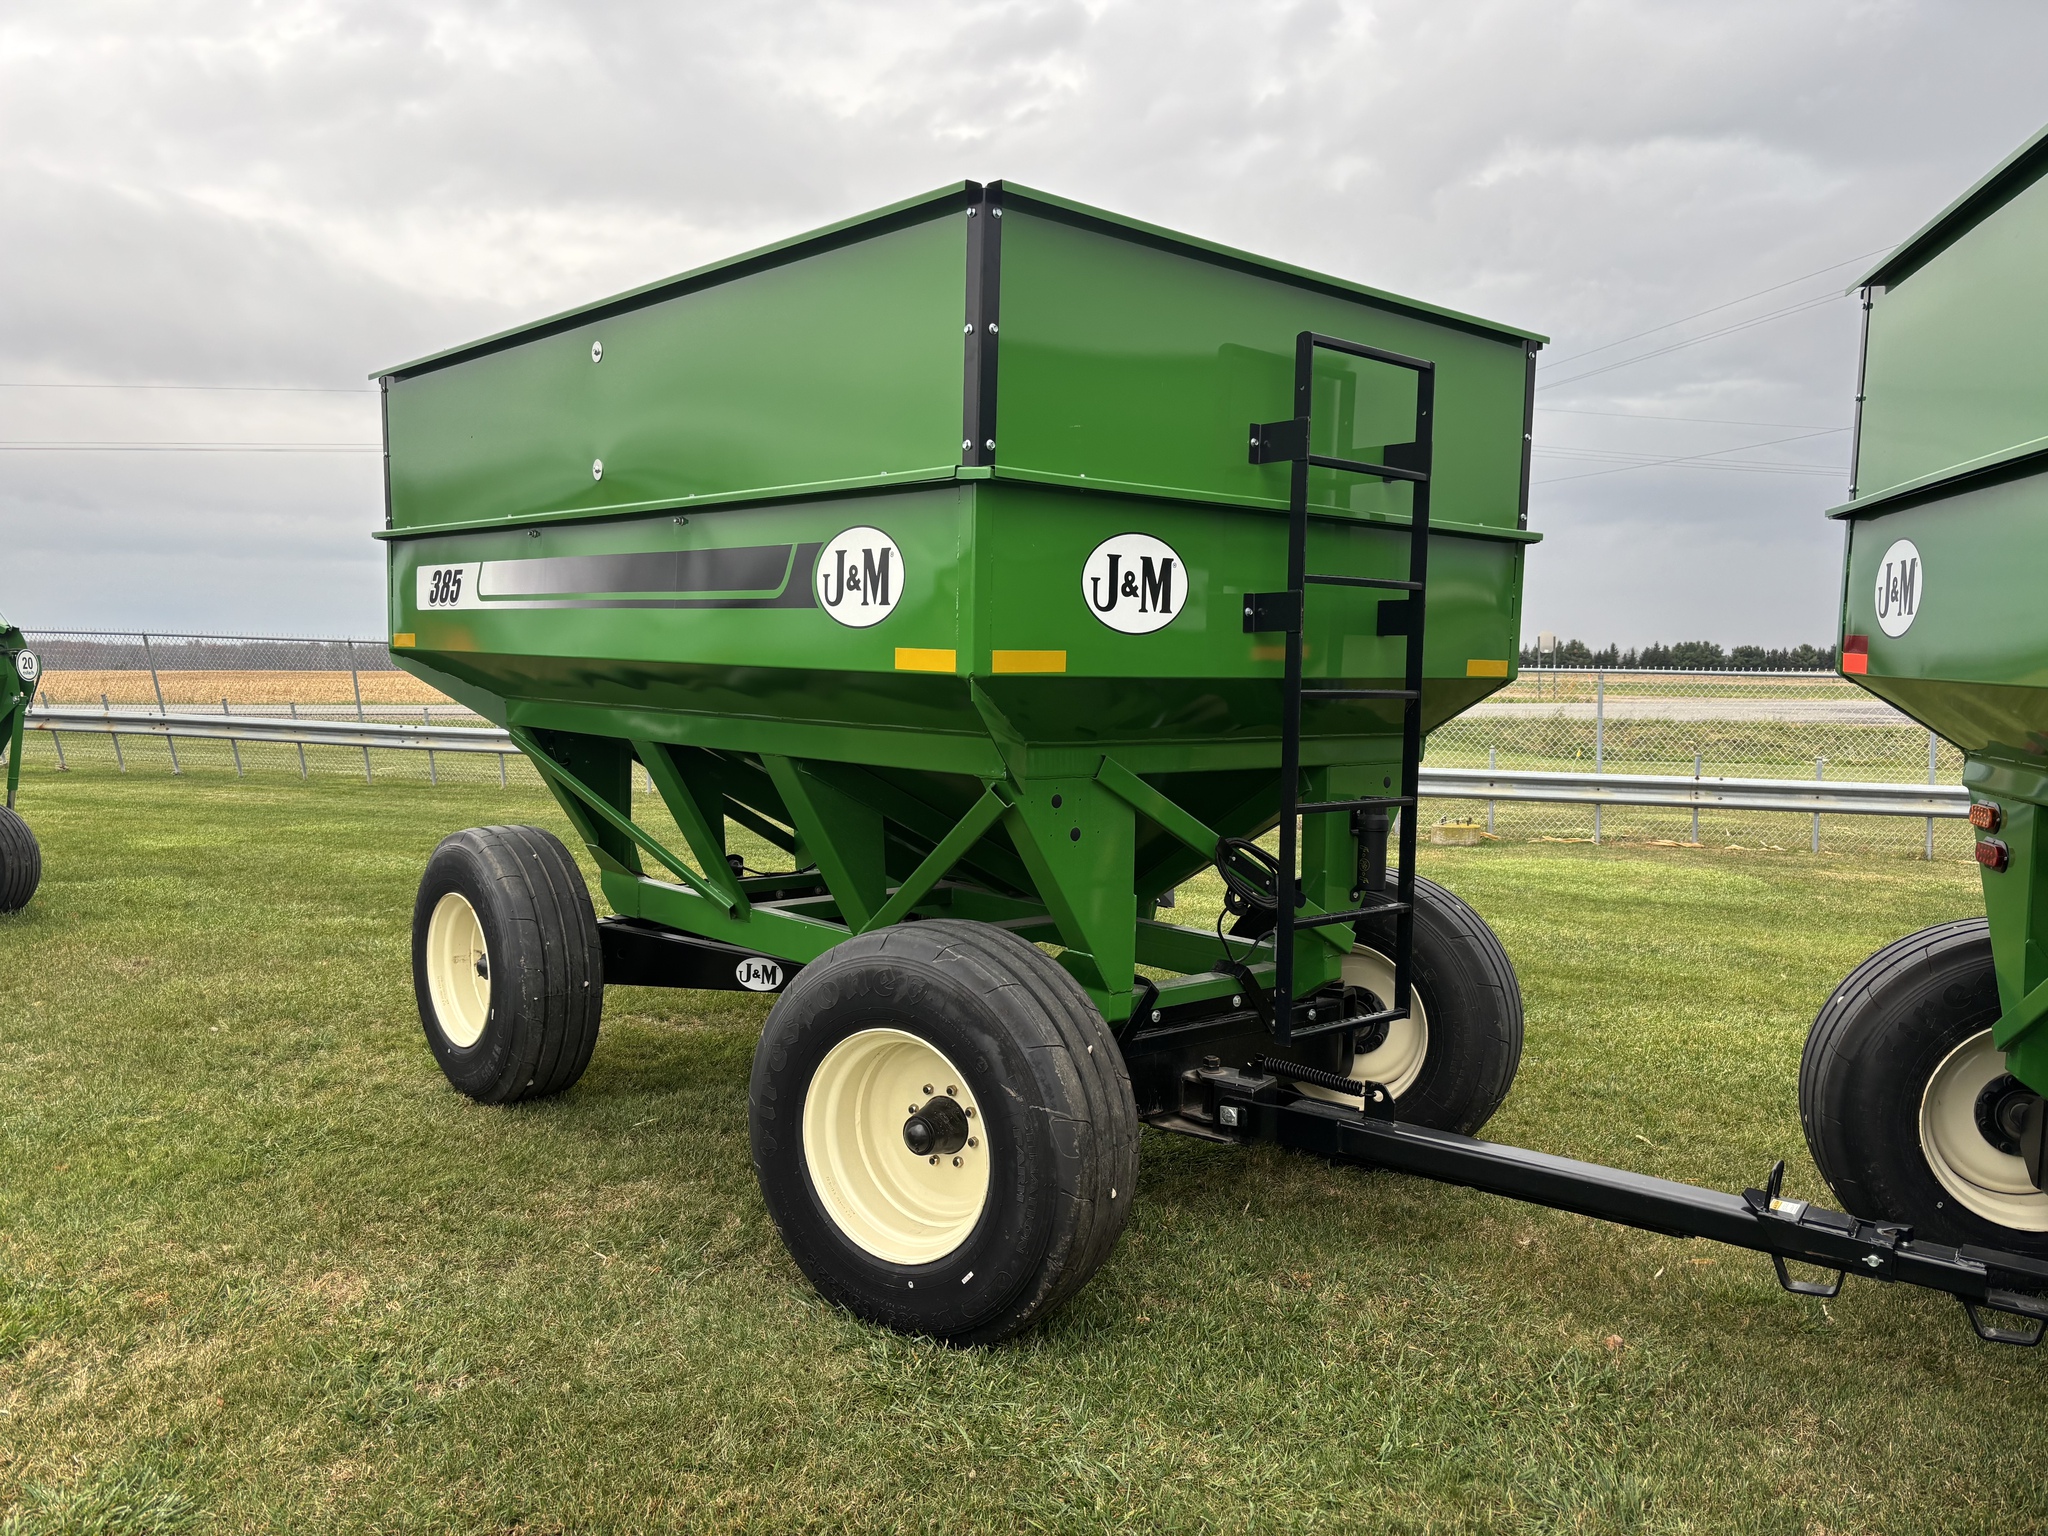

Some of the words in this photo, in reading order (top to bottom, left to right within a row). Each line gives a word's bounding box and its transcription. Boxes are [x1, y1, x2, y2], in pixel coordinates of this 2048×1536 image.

[429, 569, 463, 605] 385
[823, 547, 891, 607] J&M
[1090, 554, 1174, 613] J&M
[1878, 557, 1917, 618] J&M
[22, 656, 34, 670] 20
[738, 963, 777, 985] J&M
